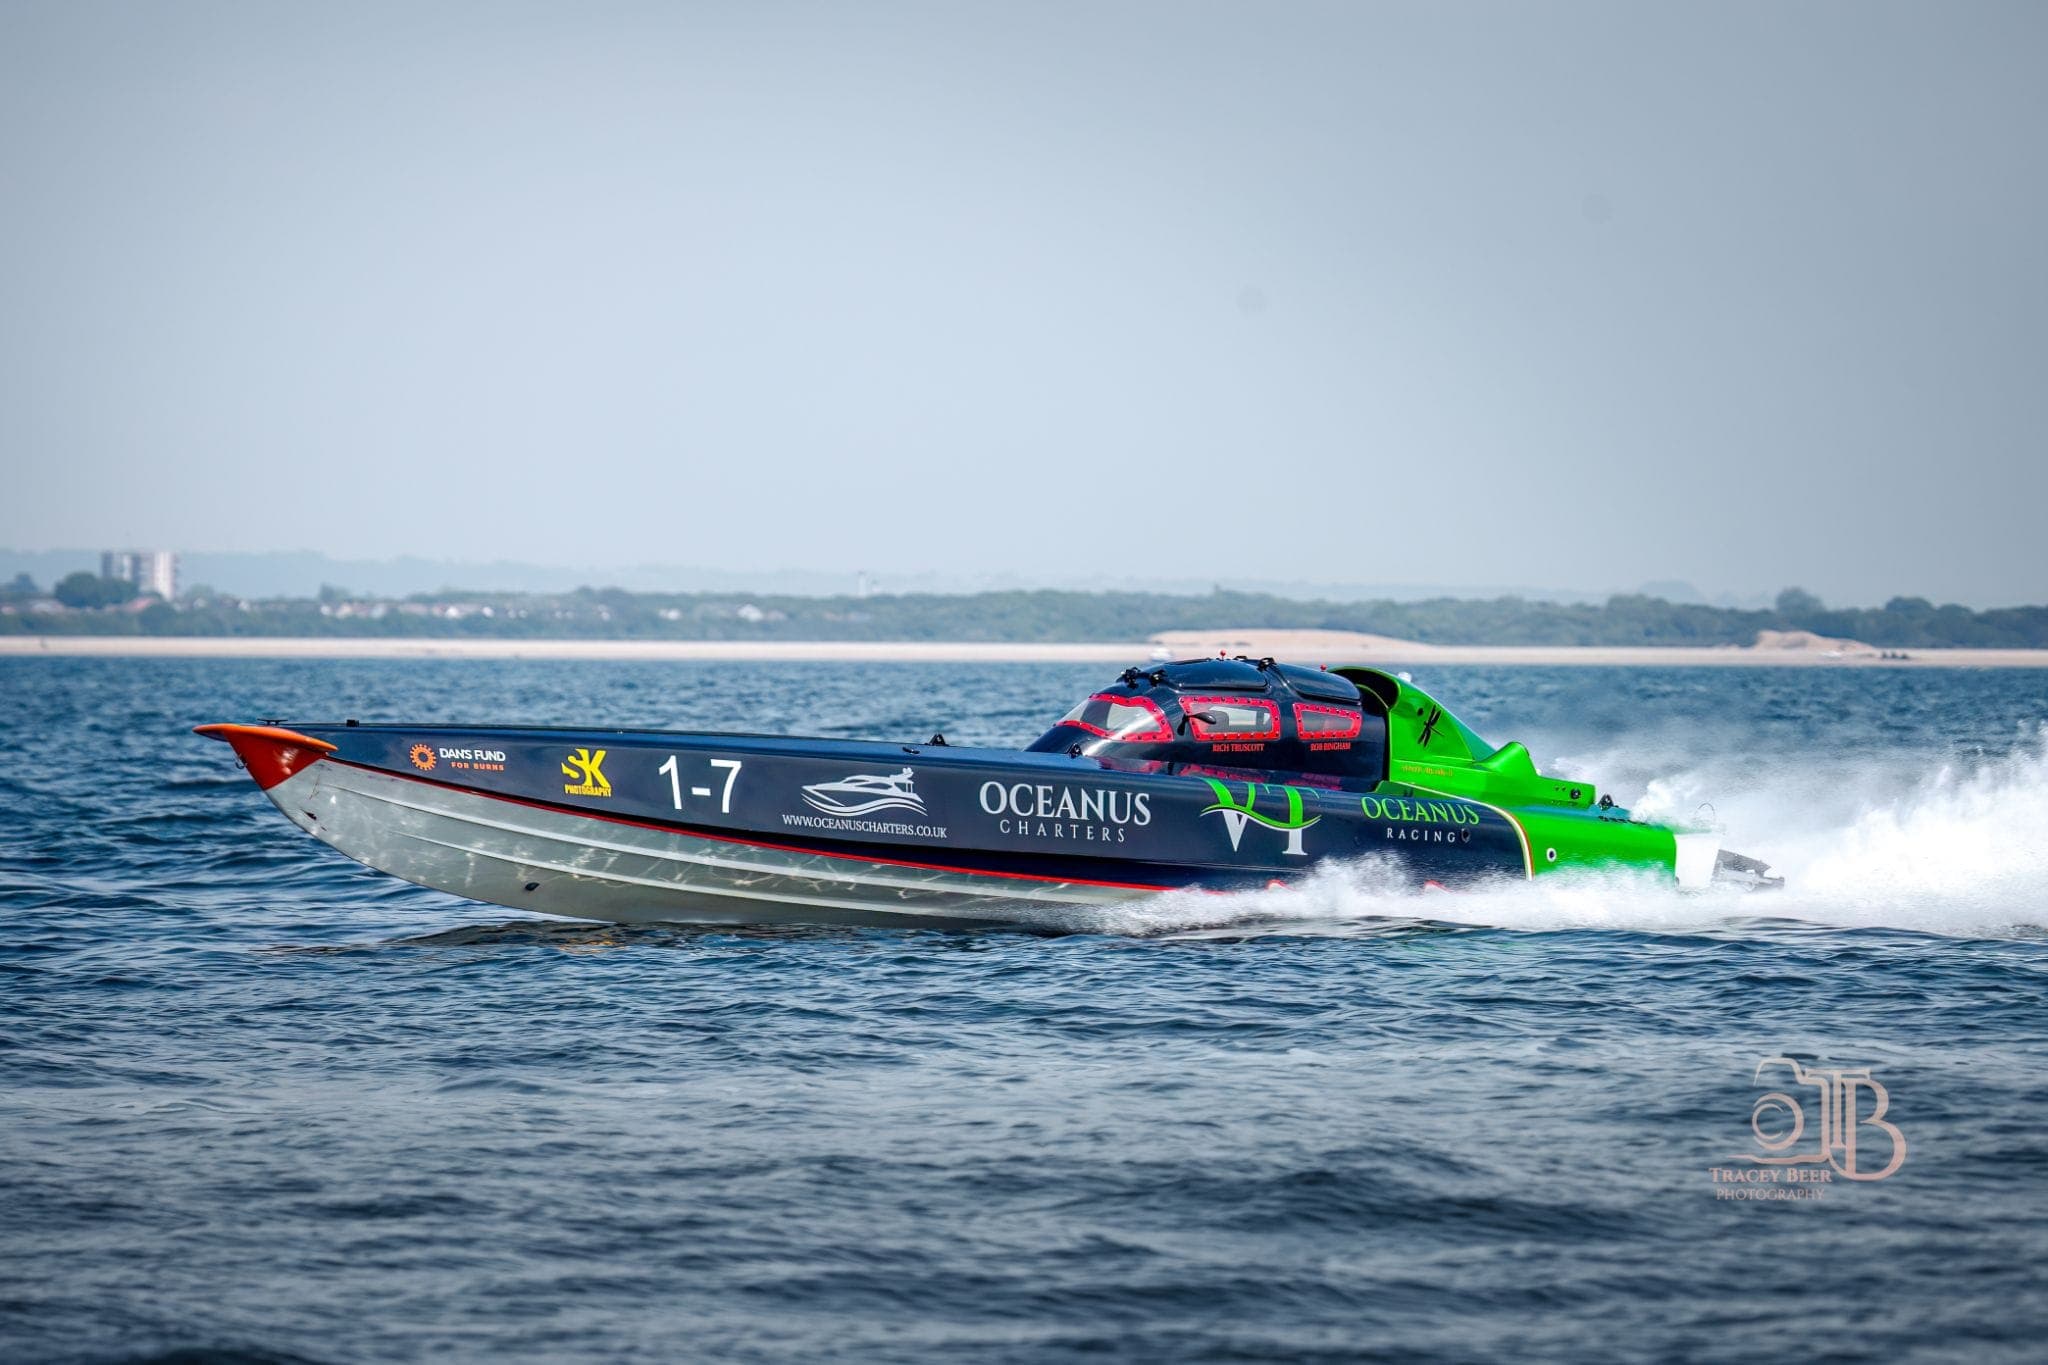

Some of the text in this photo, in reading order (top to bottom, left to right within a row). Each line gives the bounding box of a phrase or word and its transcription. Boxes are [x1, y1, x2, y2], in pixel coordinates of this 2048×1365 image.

[450, 761, 505, 771] FOR BURNS
[474, 749, 506, 762] FUND
[561, 748, 611, 788] SK
[564, 783, 612, 798] PHOTOGRAPHY
[658, 754, 742, 814] 1-7
[979, 780, 1152, 826] OCEANUS
[1361, 796, 1480, 825] OCEANUS
[781, 814, 948, 839] WWW.OCEANUSCHARTERS.CO.UK
[1000, 819, 1126, 843] CHARTERS
[1386, 827, 1457, 843] RACING
